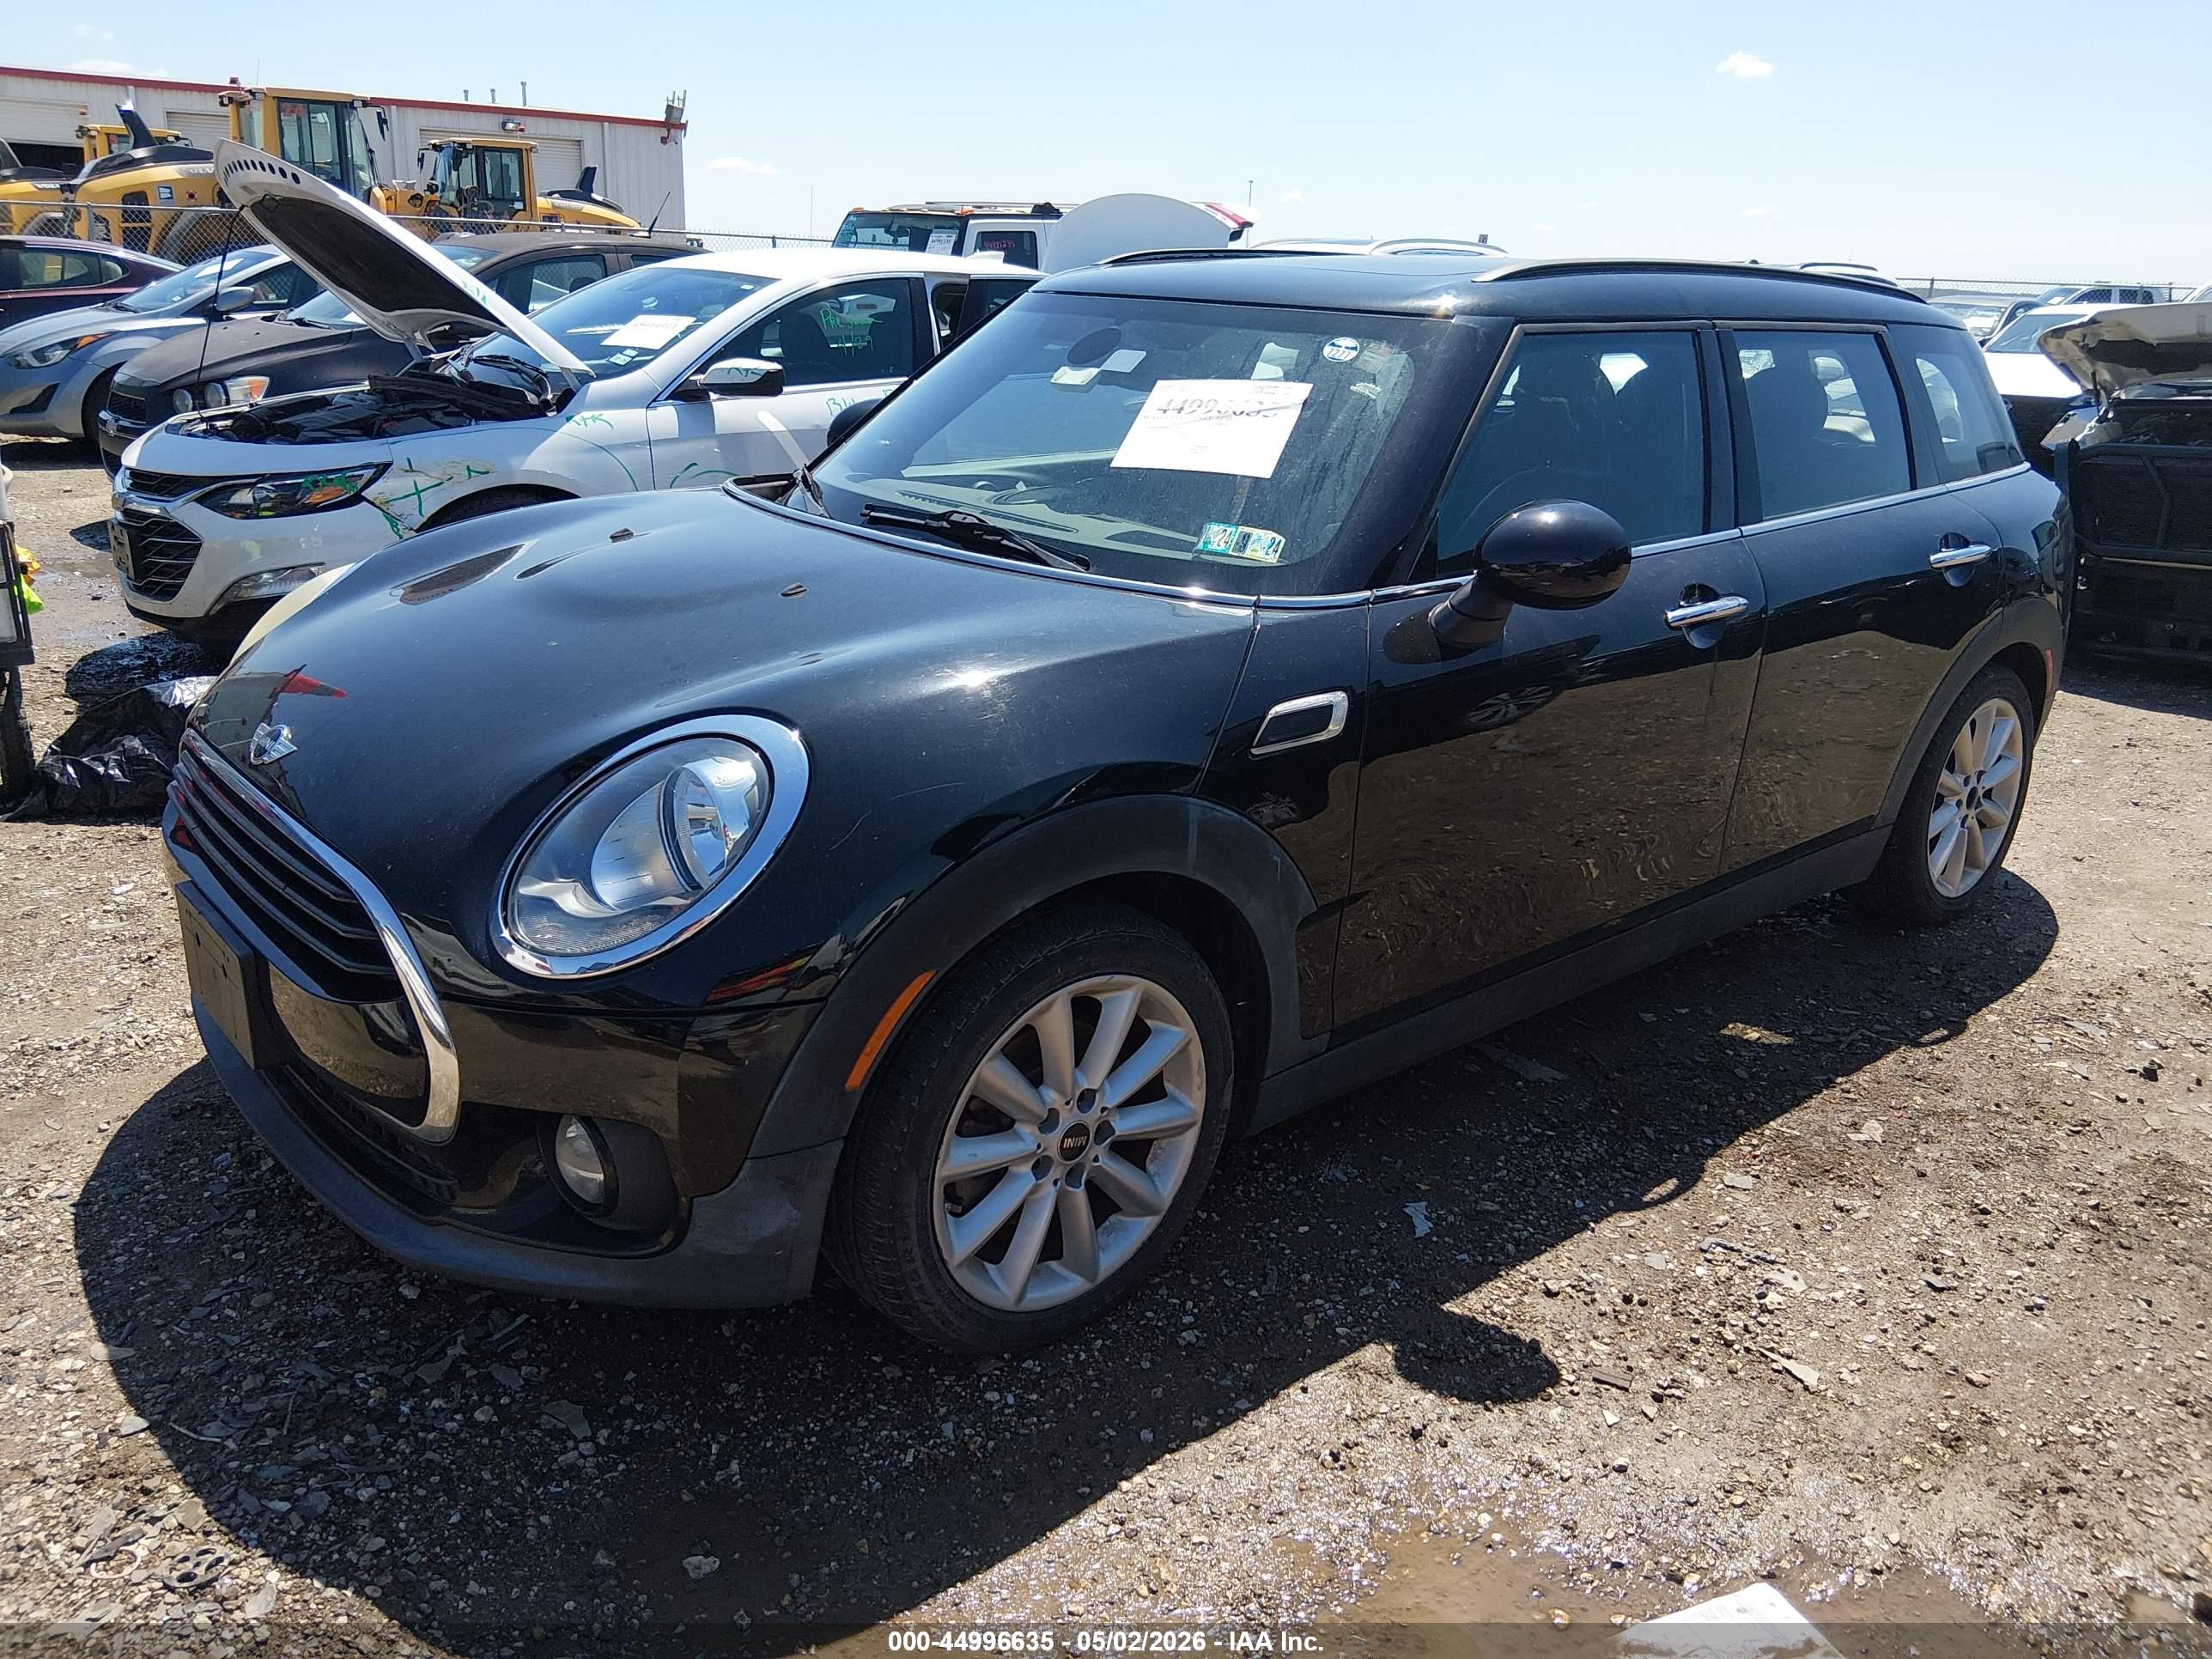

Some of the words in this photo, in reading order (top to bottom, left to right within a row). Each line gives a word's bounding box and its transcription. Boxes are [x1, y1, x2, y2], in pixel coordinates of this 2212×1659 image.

[1216, 528, 1233, 548] 24
[1265, 537, 1282, 557] 24
[1063, 1135, 1088, 1148] MINI
